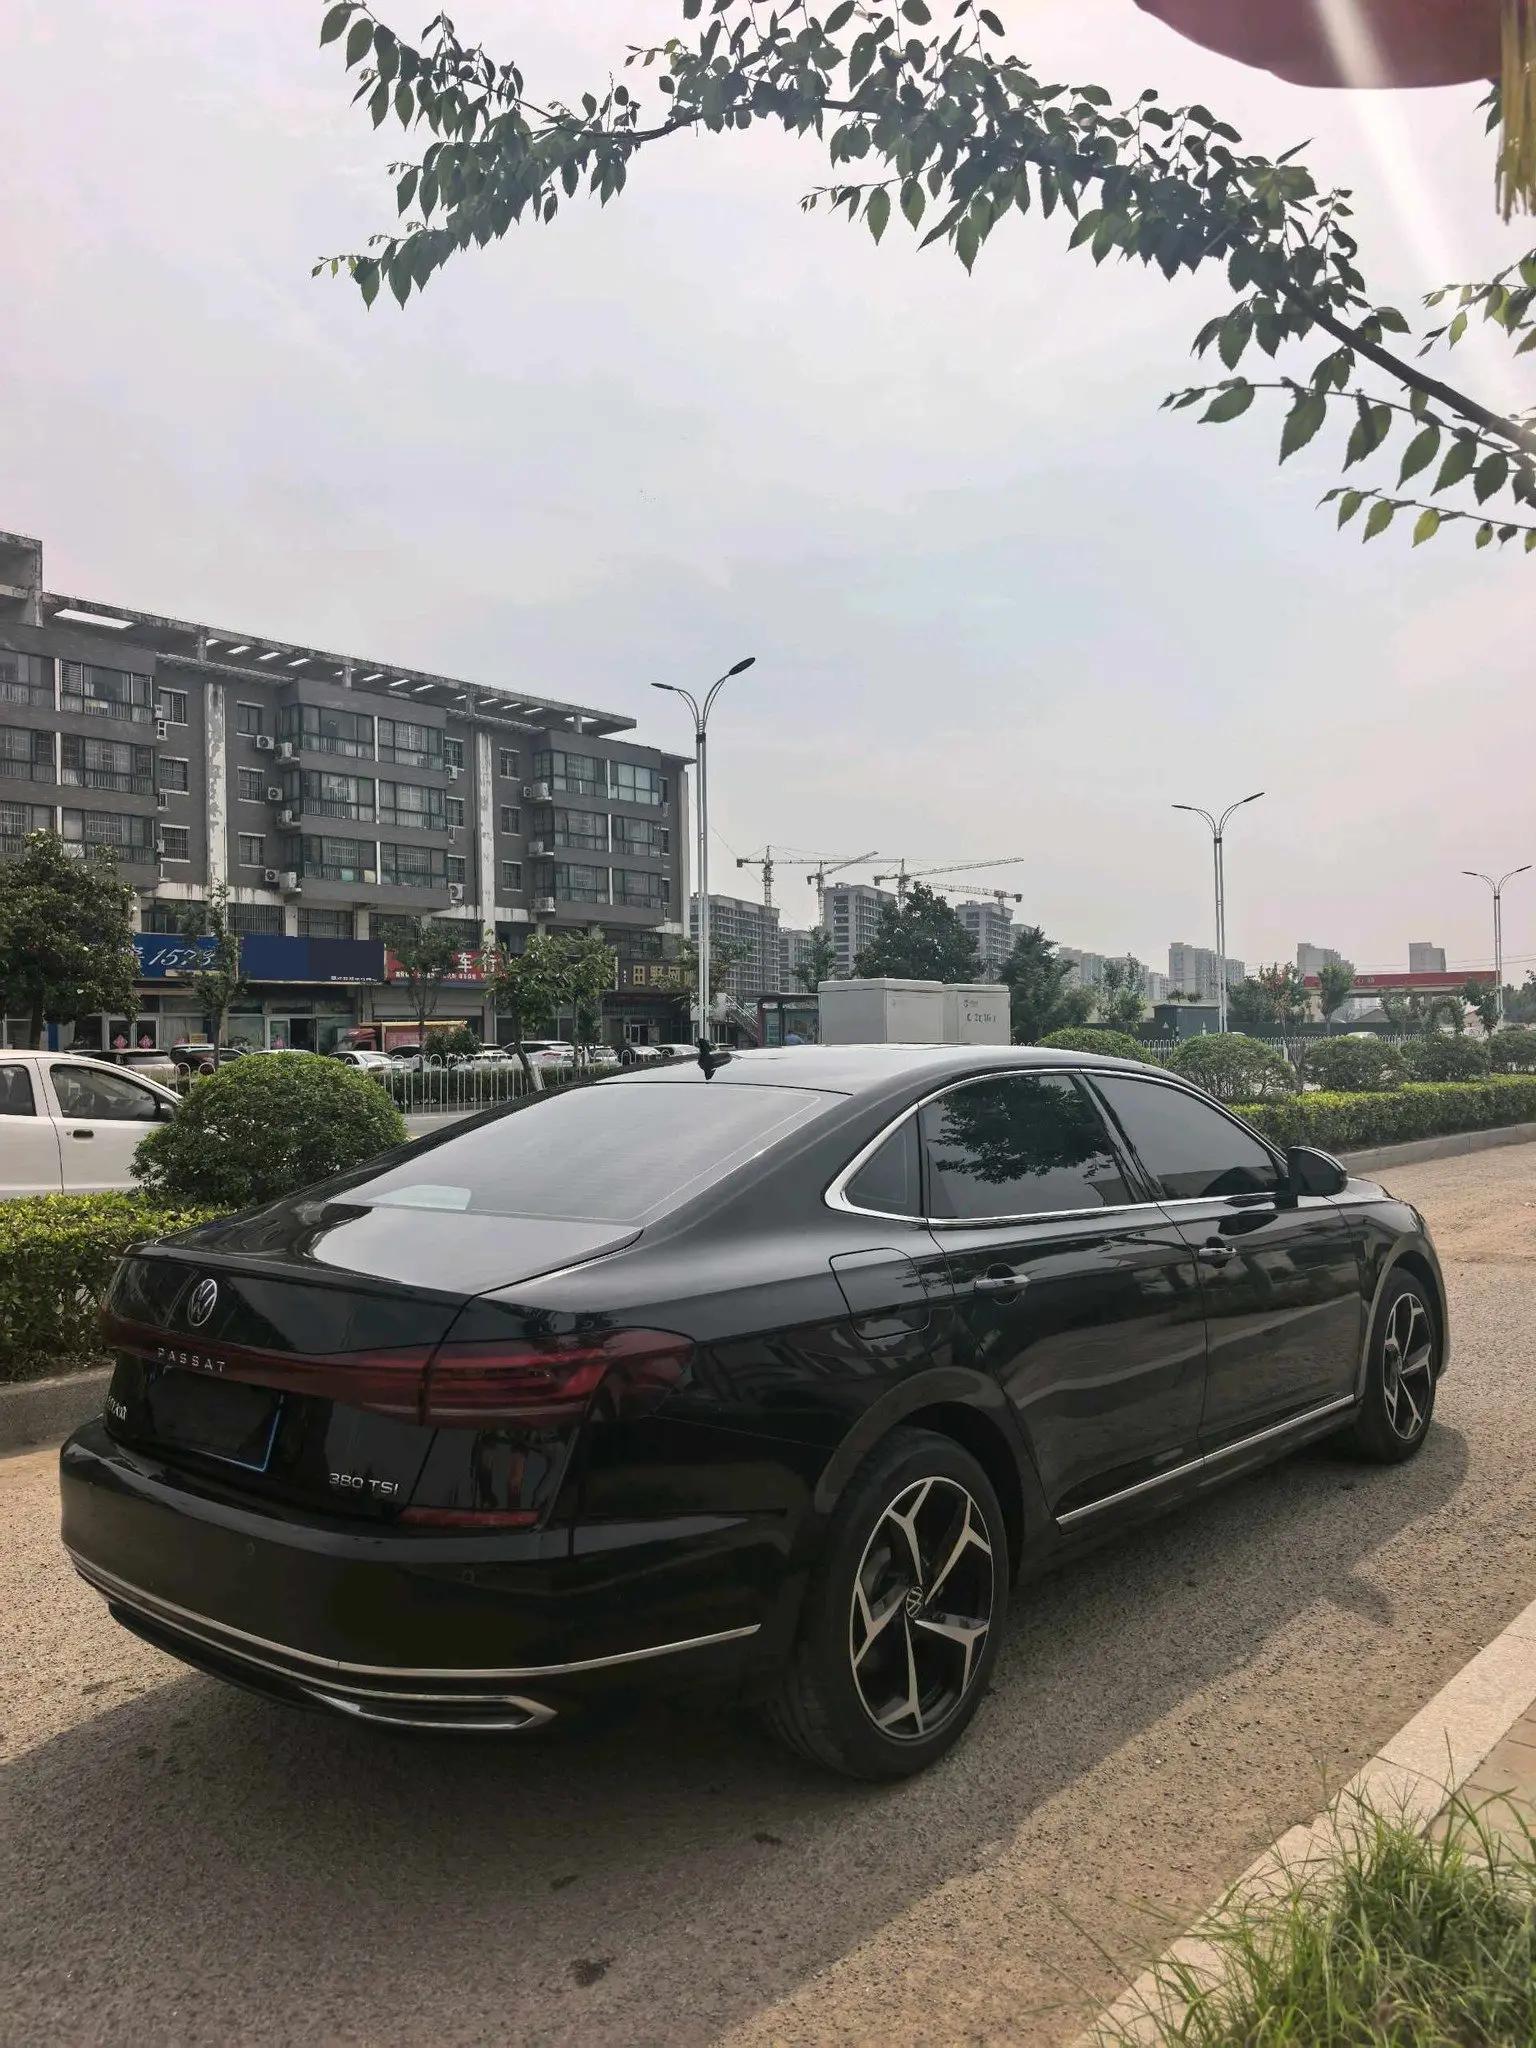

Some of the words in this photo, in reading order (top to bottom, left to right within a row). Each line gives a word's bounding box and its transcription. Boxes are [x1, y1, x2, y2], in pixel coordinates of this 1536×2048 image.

[157, 1347, 226, 1372] PASSAT
[329, 1472, 364, 1489] 380
[369, 1479, 399, 1496] TSI
